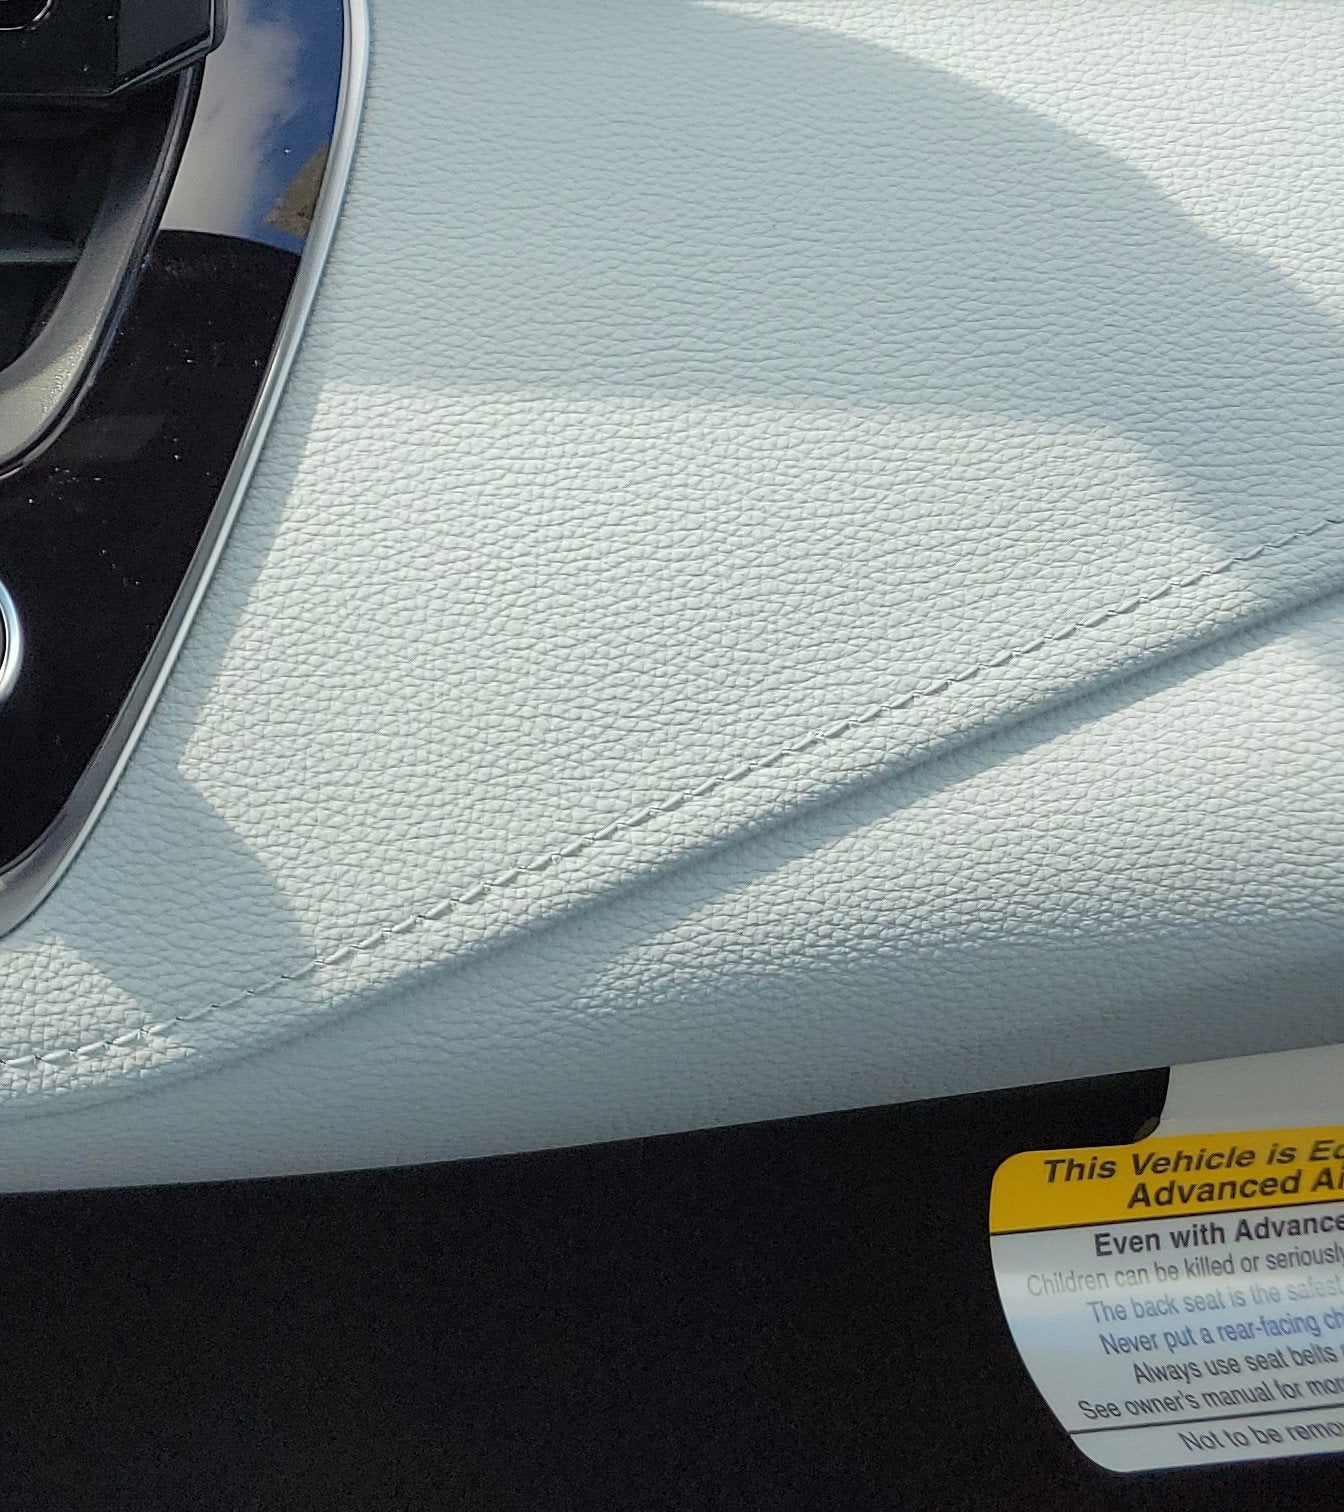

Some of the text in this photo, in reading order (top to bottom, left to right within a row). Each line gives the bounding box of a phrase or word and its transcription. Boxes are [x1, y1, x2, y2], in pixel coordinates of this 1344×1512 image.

[1043, 1156, 1117, 1183] This
[1132, 1146, 1254, 1176] Vehicle
[1268, 1143, 1297, 1166] is
[1127, 1169, 1302, 1209] Advanced
[1094, 1230, 1161, 1257] Even
[1169, 1222, 1225, 1249] with
[1026, 1272, 1108, 1299] Children
[1114, 1265, 1150, 1288] can
[1155, 1260, 1180, 1283] be
[1185, 1252, 1235, 1280] killed
[1241, 1253, 1260, 1273] or
[1087, 1300, 1127, 1326] The
[1133, 1292, 1178, 1320] back
[1184, 1286, 1227, 1313] seat
[1231, 1285, 1246, 1307] is
[1251, 1280, 1282, 1306] the
[1099, 1332, 1160, 1356] Never
[1164, 1330, 1197, 1354] put
[1200, 1326, 1215, 1345] a
[1216, 1310, 1321, 1345] rear-facing
[1132, 1361, 1203, 1390] Always
[1207, 1355, 1242, 1377] use
[1246, 1347, 1290, 1374] seat
[1287, 1343, 1338, 1367] belts
[1078, 1400, 1122, 1422] See
[1124, 1390, 1201, 1417] owner's
[1203, 1379, 1274, 1408] manual
[1273, 1378, 1304, 1401] for
[1178, 1428, 1222, 1452] Not
[1225, 1425, 1250, 1448] to
[1254, 1420, 1283, 1445] be
